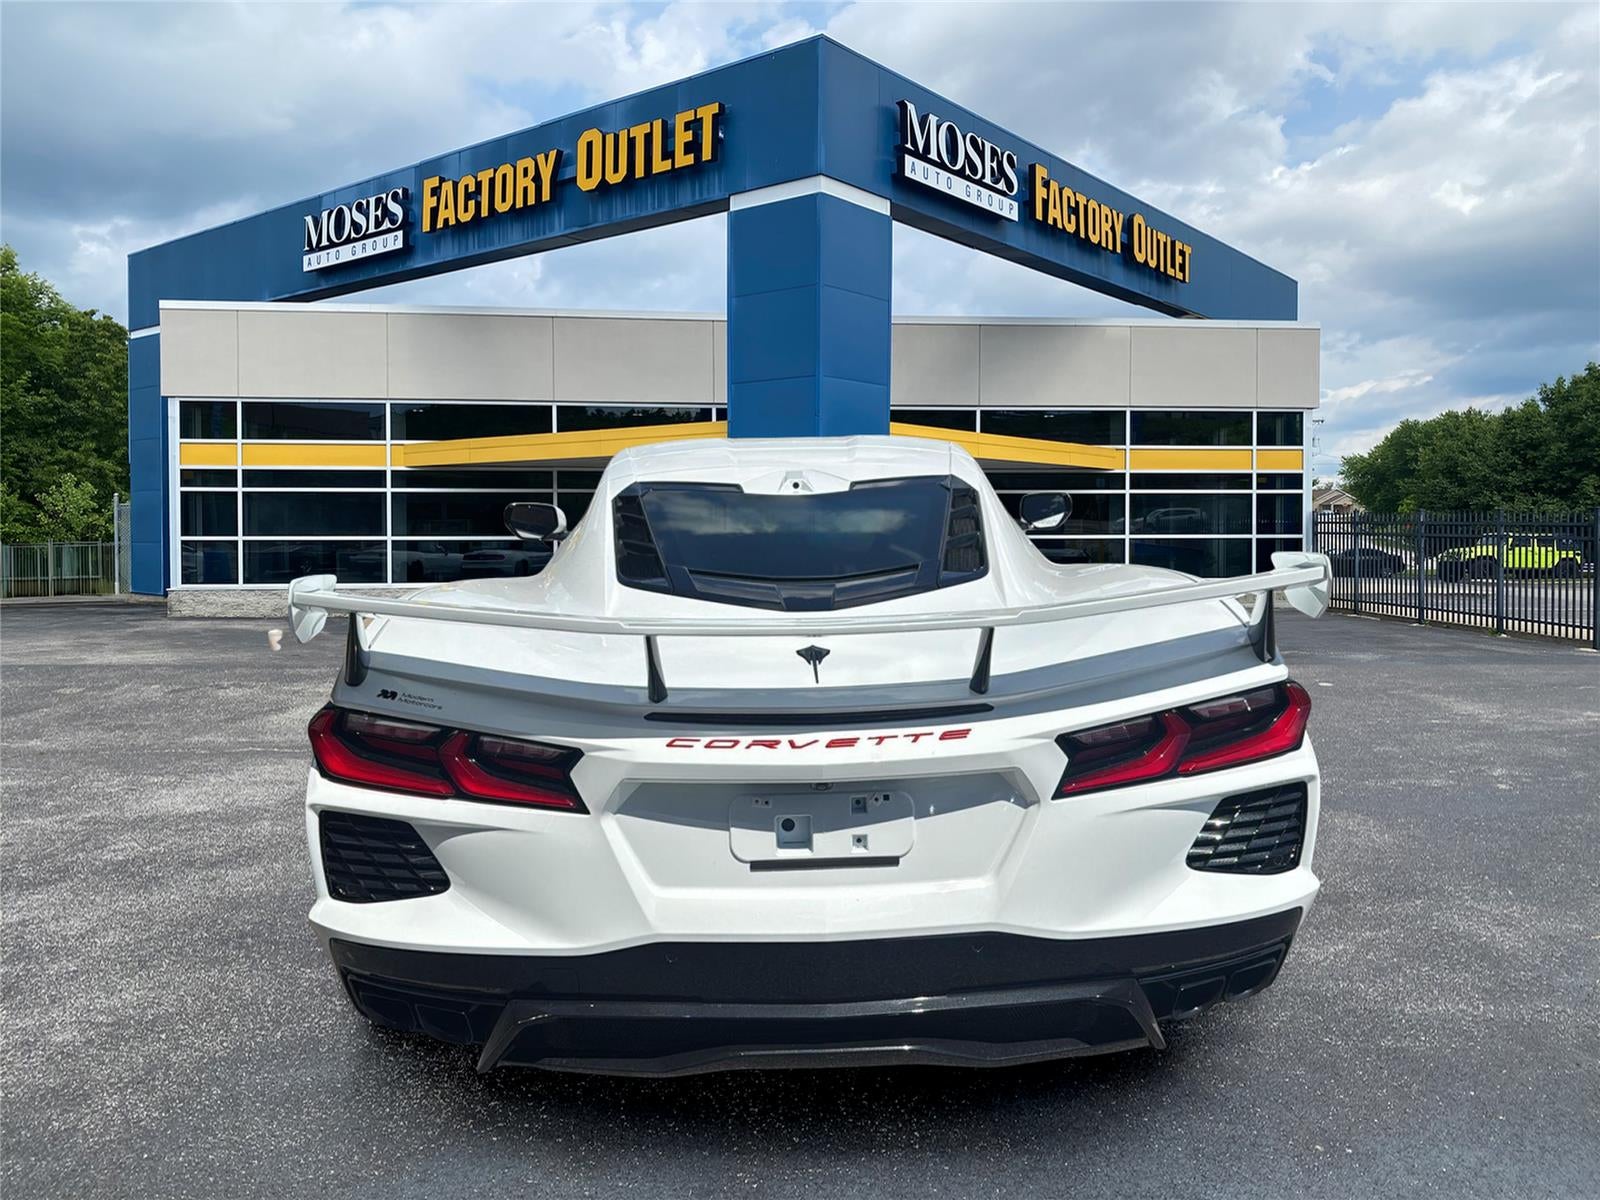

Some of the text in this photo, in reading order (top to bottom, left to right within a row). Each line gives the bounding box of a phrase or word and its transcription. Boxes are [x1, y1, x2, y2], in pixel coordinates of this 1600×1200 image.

[422, 102, 720, 232] FACTORY OUTLET
[904, 100, 1018, 196] MOSES
[304, 187, 404, 251] MOSES
[910, 161, 1015, 216] AUTO GROUP
[307, 235, 400, 268] AUTO GROUP
[1034, 163, 1192, 283] FACTORY OUTLET
[666, 728, 972, 749] CORVETTE
